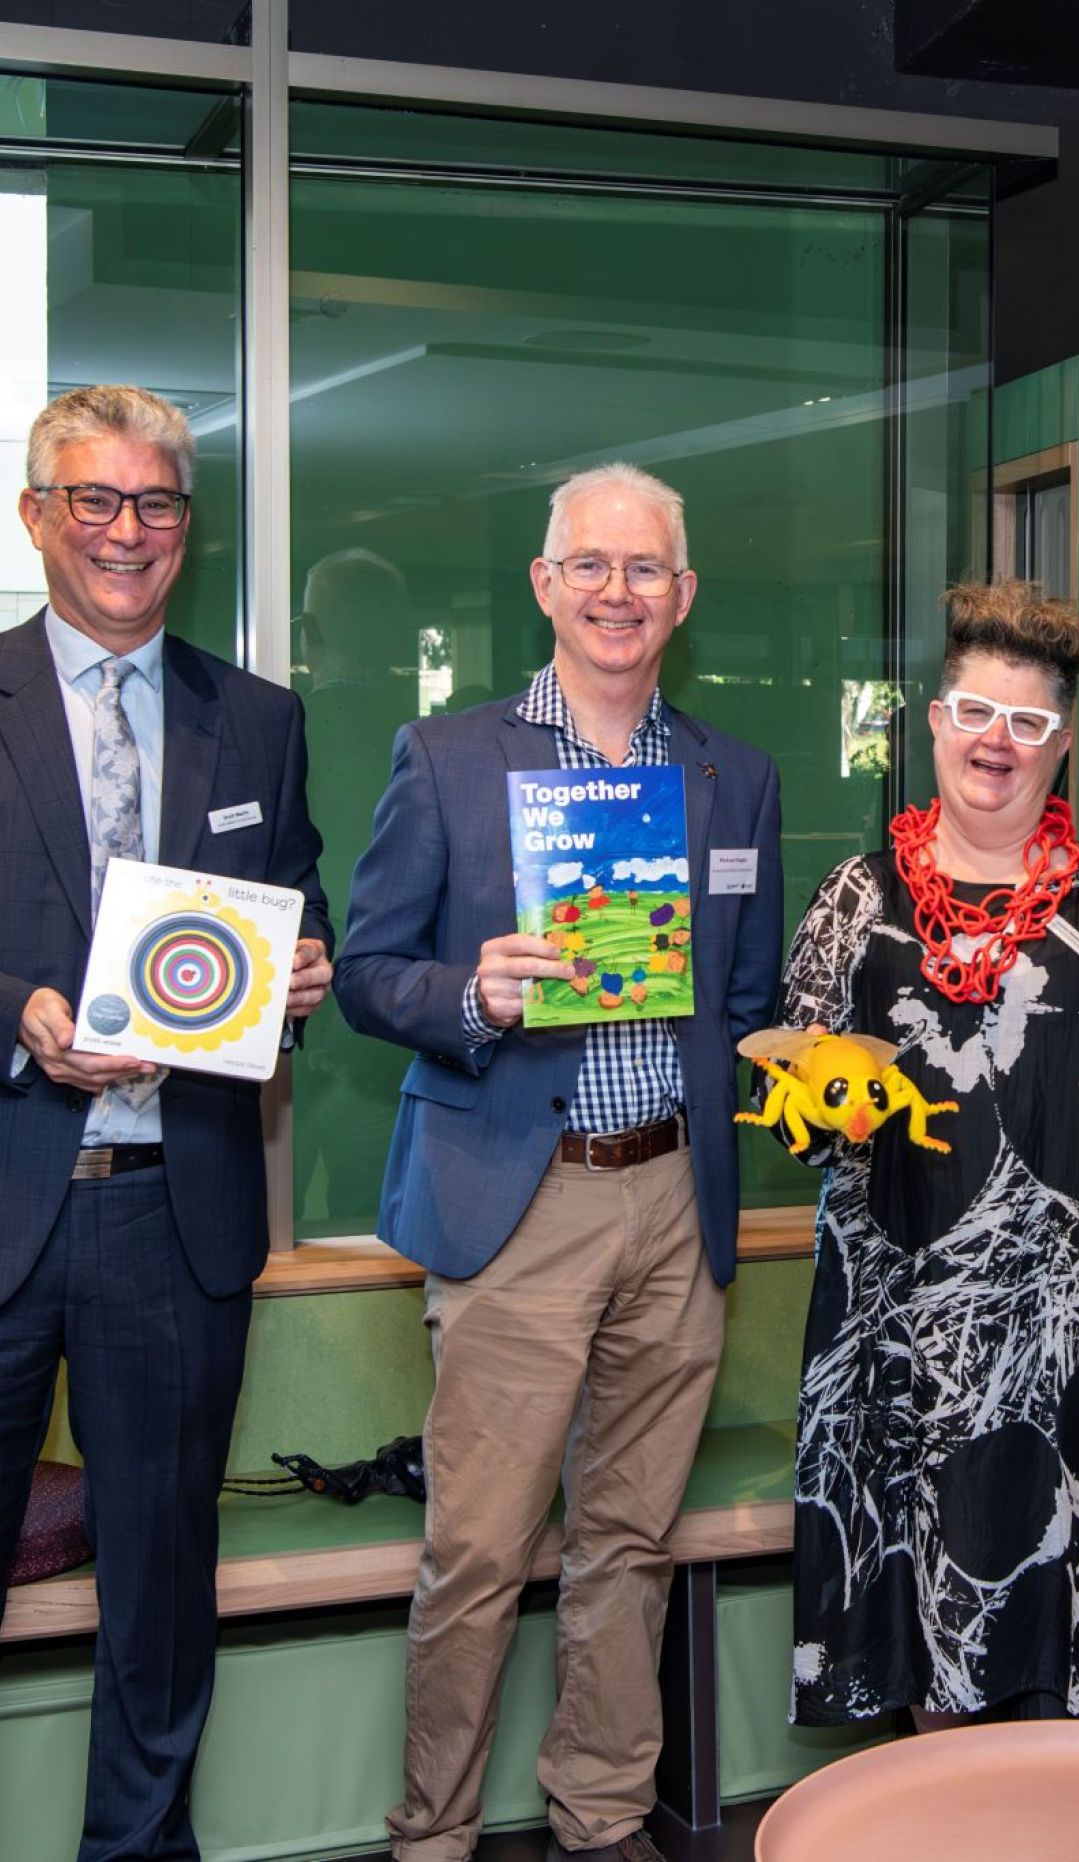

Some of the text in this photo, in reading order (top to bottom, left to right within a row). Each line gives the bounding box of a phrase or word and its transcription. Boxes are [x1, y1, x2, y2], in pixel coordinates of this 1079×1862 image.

[520, 780, 641, 807] Together
[523, 807, 565, 828] We
[524, 831, 595, 851] Grow
[228, 887, 297, 911] little bug?
